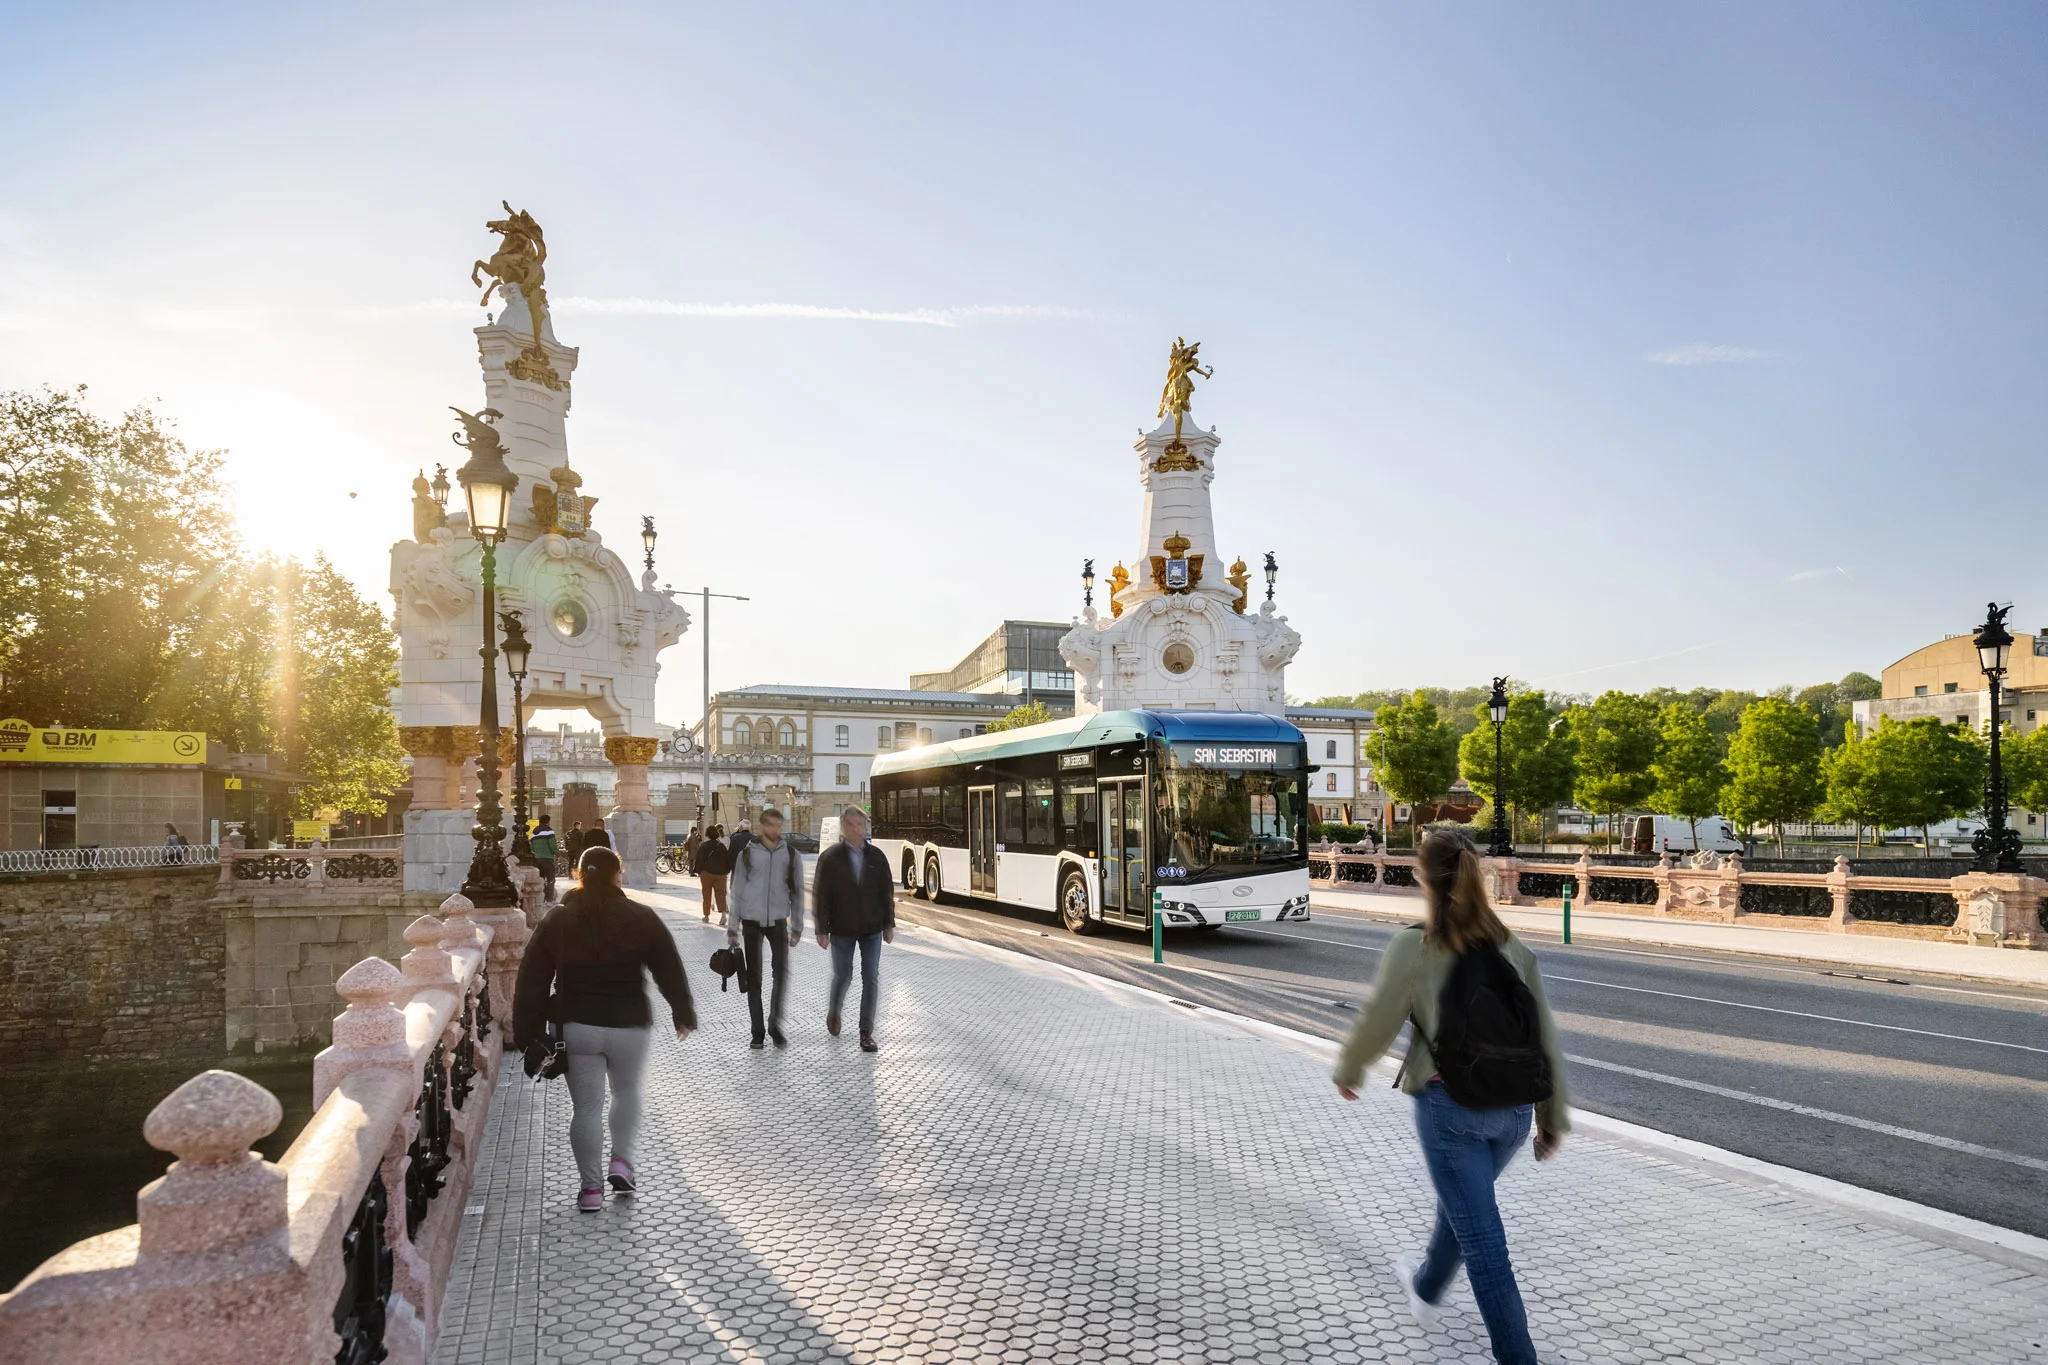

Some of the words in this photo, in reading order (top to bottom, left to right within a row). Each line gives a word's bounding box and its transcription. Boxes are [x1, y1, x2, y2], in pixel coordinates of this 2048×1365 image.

[64, 732, 97, 746] BM
[1194, 748, 1217, 763] SAN
[1219, 748, 1277, 763] SEBASTIAN
